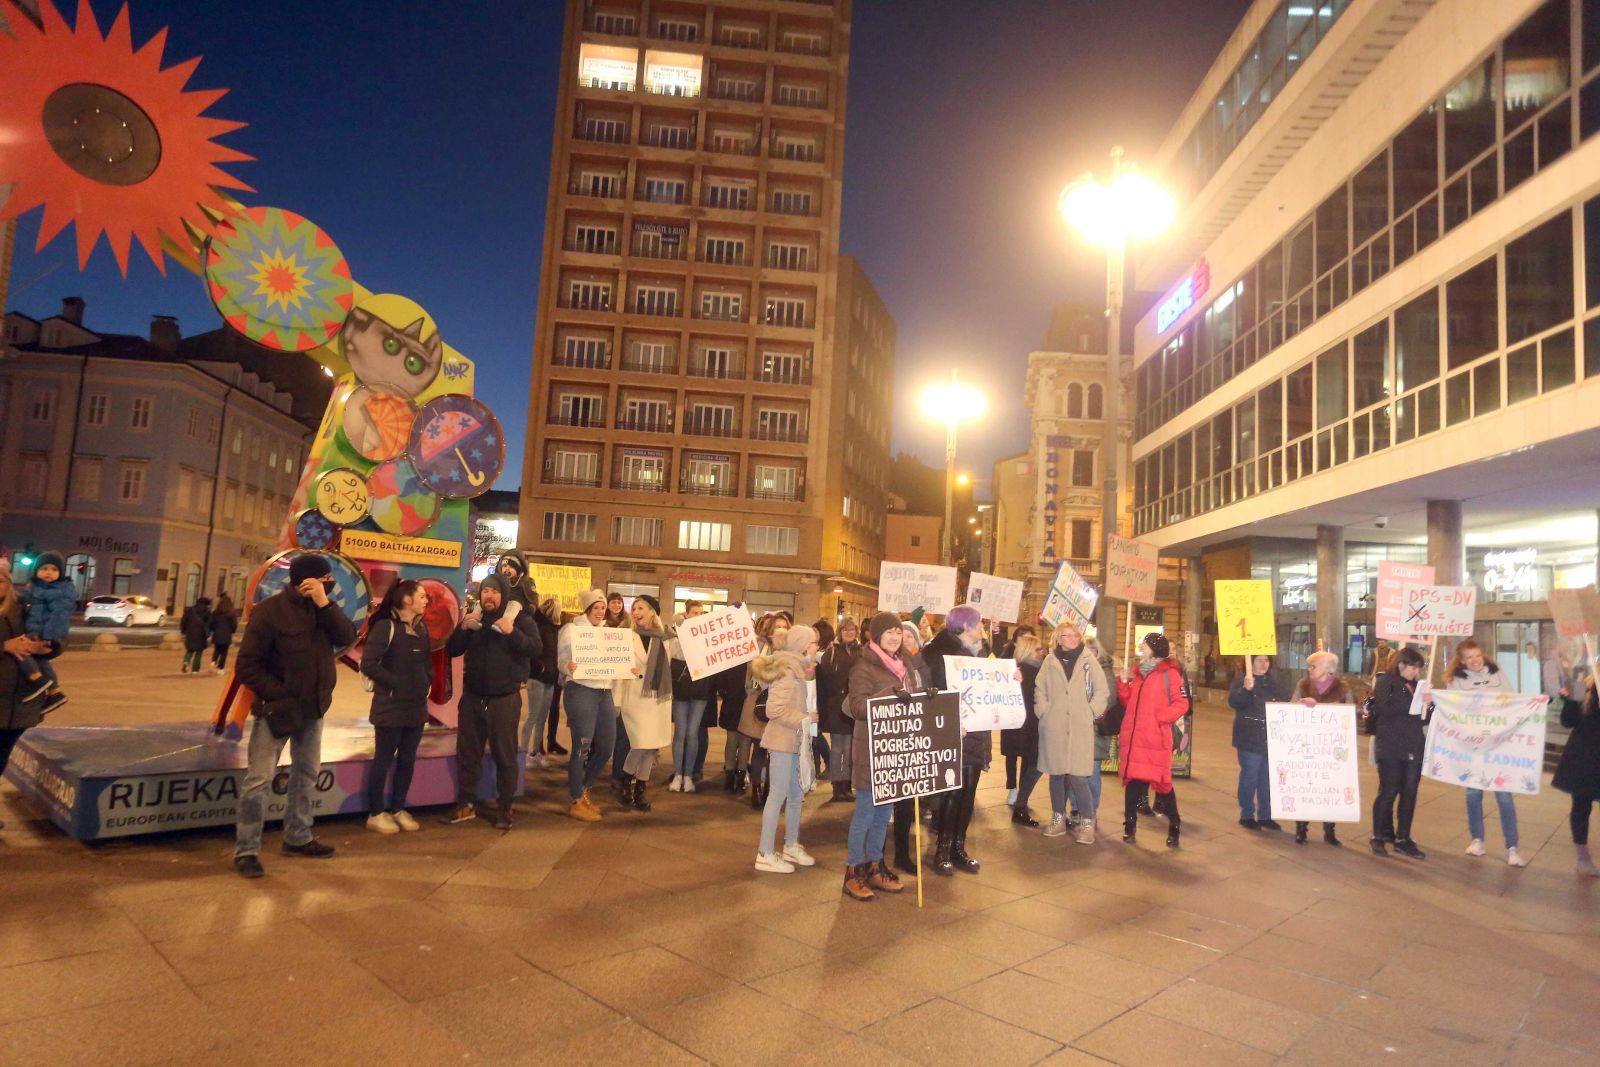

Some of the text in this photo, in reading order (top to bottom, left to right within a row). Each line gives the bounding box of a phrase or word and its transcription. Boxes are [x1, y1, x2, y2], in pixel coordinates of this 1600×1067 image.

[345, 537, 458, 557] 51000 BALTHAZARGRAD
[1409, 588, 1440, 603] DPS
[1453, 590, 1472, 607] DV
[691, 614, 735, 637] DIJETE
[1235, 617, 1252, 639] 1.
[1414, 619, 1471, 634] ČUVALIŠTE
[603, 632, 624, 641] NISU
[705, 626, 750, 648] ISPRED
[705, 640, 757, 667] INTERESA
[962, 668, 984, 681] DPS
[995, 670, 1009, 684] DV
[872, 702, 924, 720] MINISTAR
[873, 715, 945, 735] ZALUTAO U
[874, 733, 932, 754] POGREŠNO
[874, 748, 957, 770] MINISTARSTVO!
[874, 763, 939, 785] ODGAJATELJI
[108, 776, 238, 810] RIJEKA
[875, 783, 897, 800] NISU
[106, 810, 237, 828] EUROPEAN CAPITA
